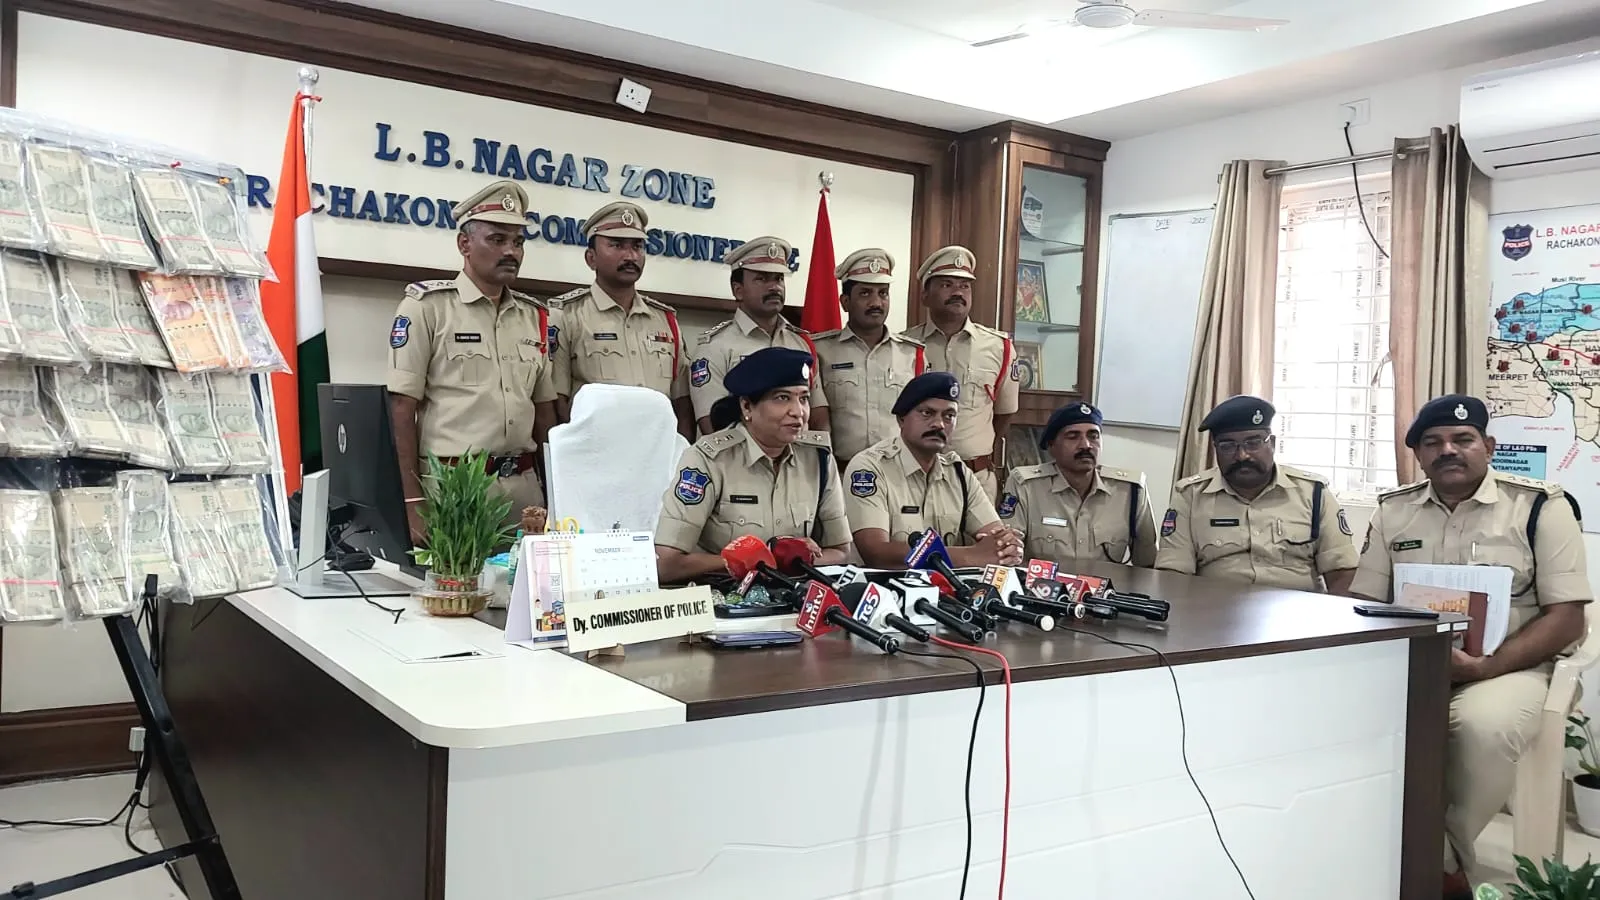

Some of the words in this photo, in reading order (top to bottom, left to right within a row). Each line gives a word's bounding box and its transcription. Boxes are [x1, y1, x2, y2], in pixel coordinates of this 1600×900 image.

[619, 164, 717, 209] ZONE
[1535, 227, 1558, 238] L.B.
[1488, 373, 1528, 381] MEERPET
[679, 482, 704, 495] POLICE
[572, 616, 588, 634] Dy.
[590, 606, 663, 629] COMMISSIONER
[664, 604, 677, 619] OF
[677, 599, 709, 618] POLICE
[805, 589, 825, 630] hmtv
[858, 592, 879, 623] TG5
